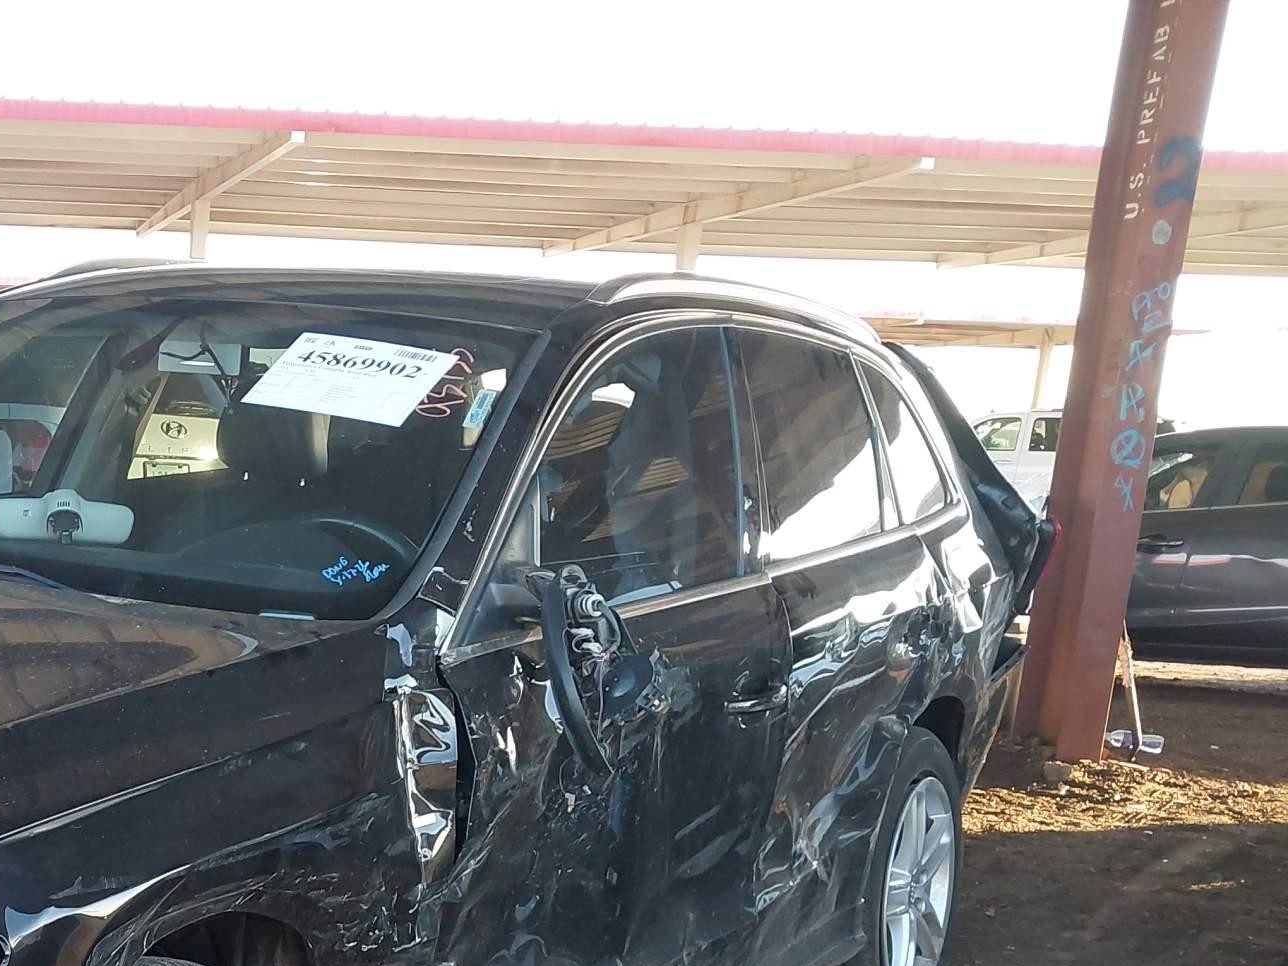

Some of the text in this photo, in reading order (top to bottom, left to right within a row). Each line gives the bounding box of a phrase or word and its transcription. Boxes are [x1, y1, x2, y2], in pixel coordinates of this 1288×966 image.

[1124, 162, 1147, 220] U.S.
[1136, 24, 1170, 145] PREFAB
[297, 349, 423, 379] 45869902
